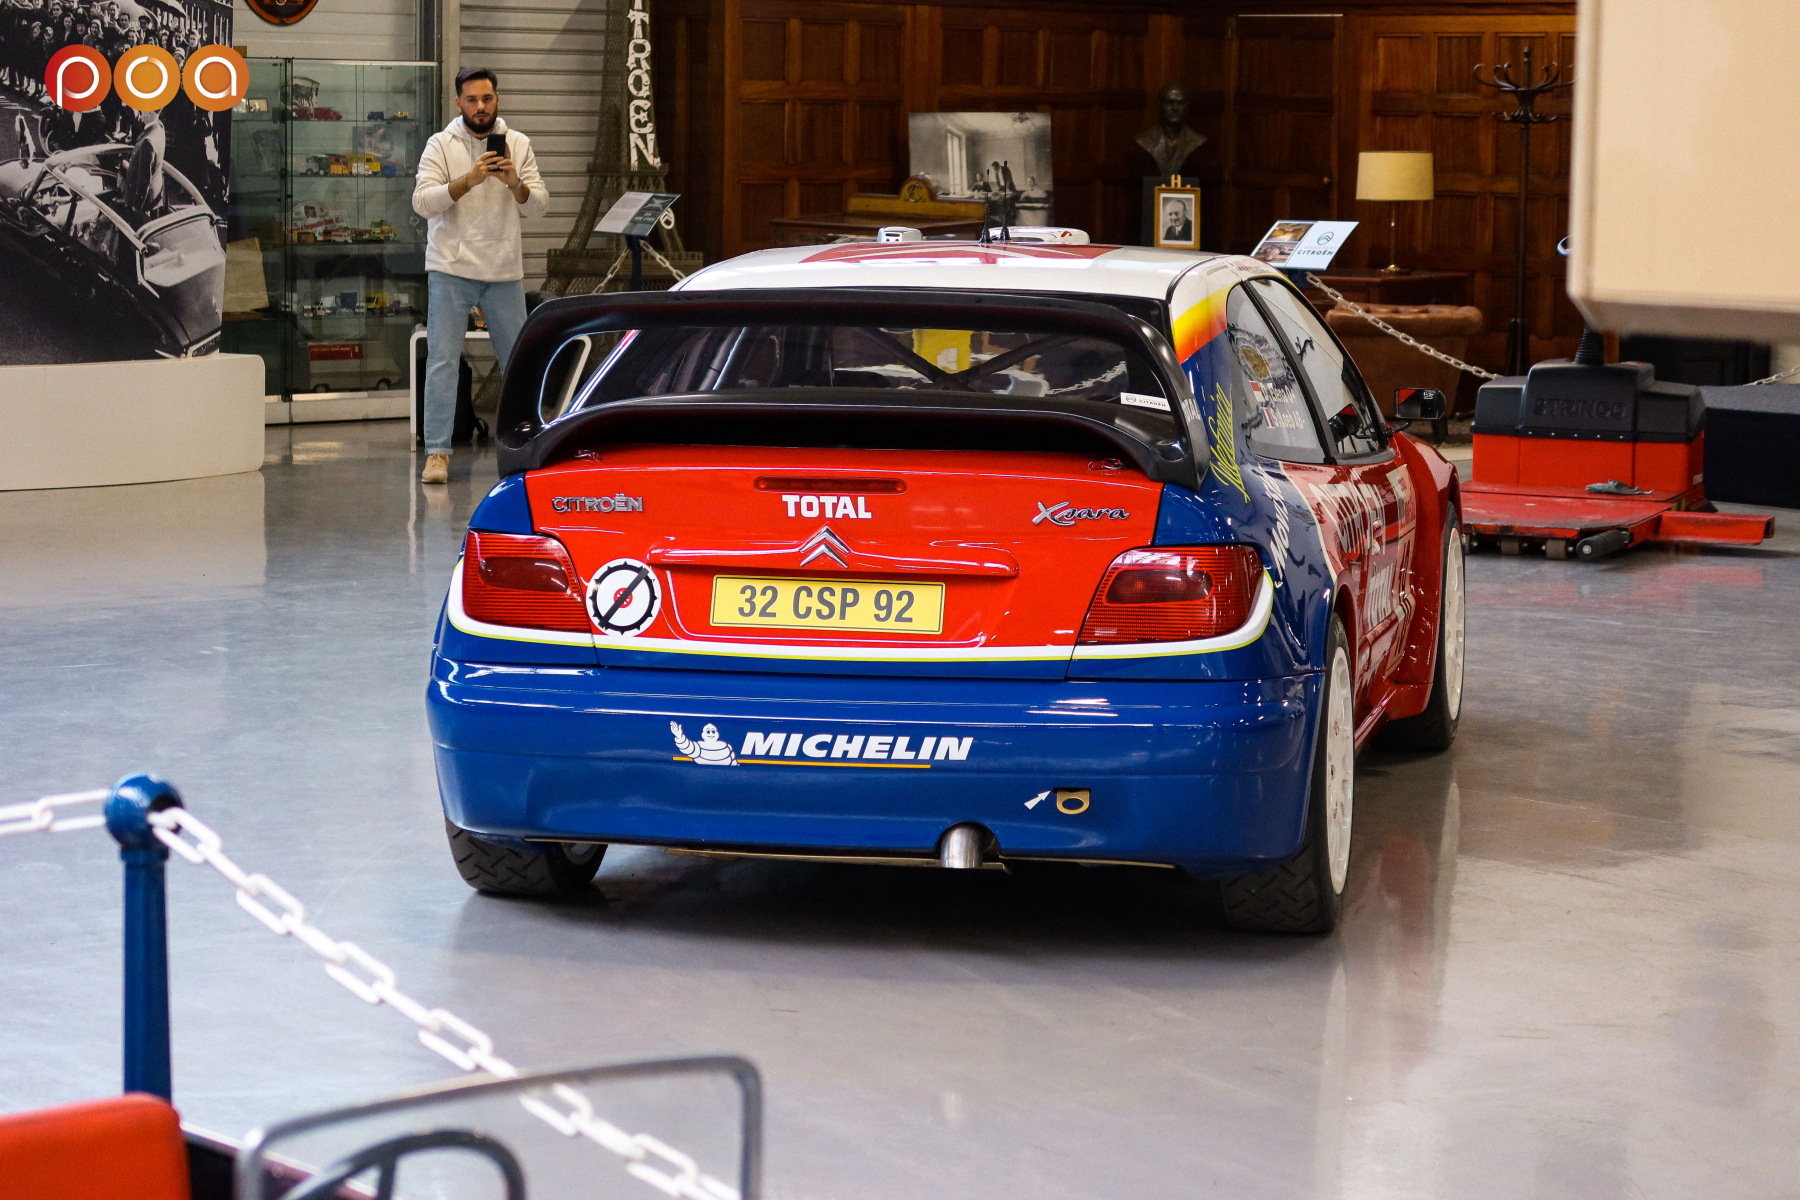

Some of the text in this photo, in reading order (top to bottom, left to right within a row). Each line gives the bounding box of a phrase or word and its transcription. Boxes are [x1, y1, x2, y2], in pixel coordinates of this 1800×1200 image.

[1533, 397, 1626, 420] STRINGO
[552, 493, 643, 513] CITROËN
[781, 494, 872, 519] TOTAL
[1032, 500, 1130, 526] Xsara
[738, 585, 915, 623] 32 CSP 92
[740, 731, 974, 761] MICHELIN
